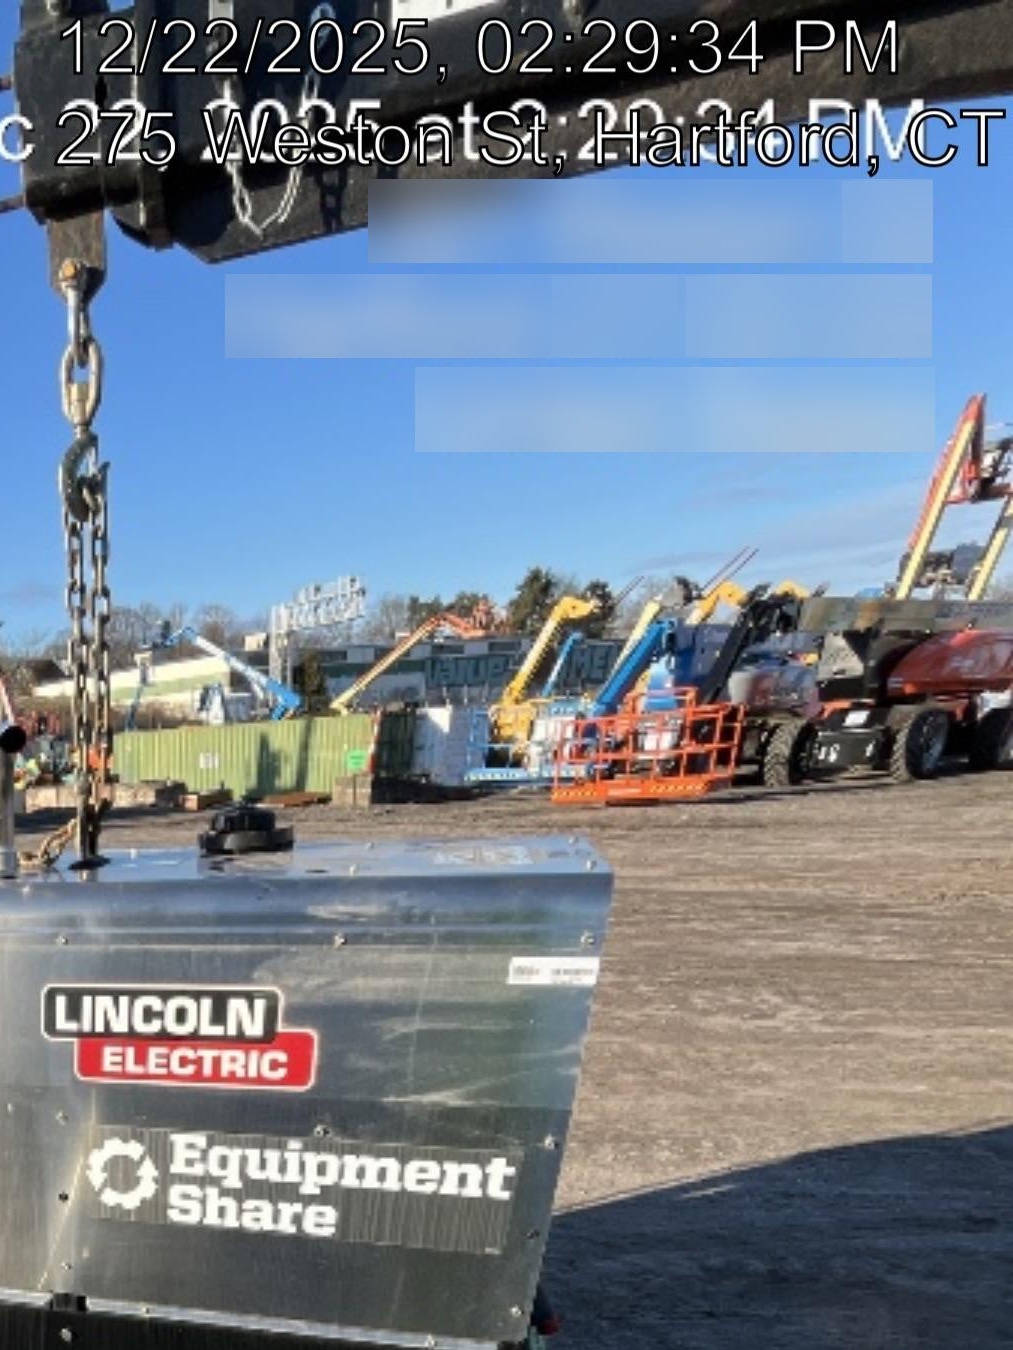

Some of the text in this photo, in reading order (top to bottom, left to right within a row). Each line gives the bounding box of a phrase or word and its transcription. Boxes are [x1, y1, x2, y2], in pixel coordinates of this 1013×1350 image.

[54, 994, 267, 1037] LINCOLN
[100, 1045, 289, 1079] ELECTRIC
[168, 1132, 517, 1202] Equipment
[168, 1184, 339, 1237] Share
